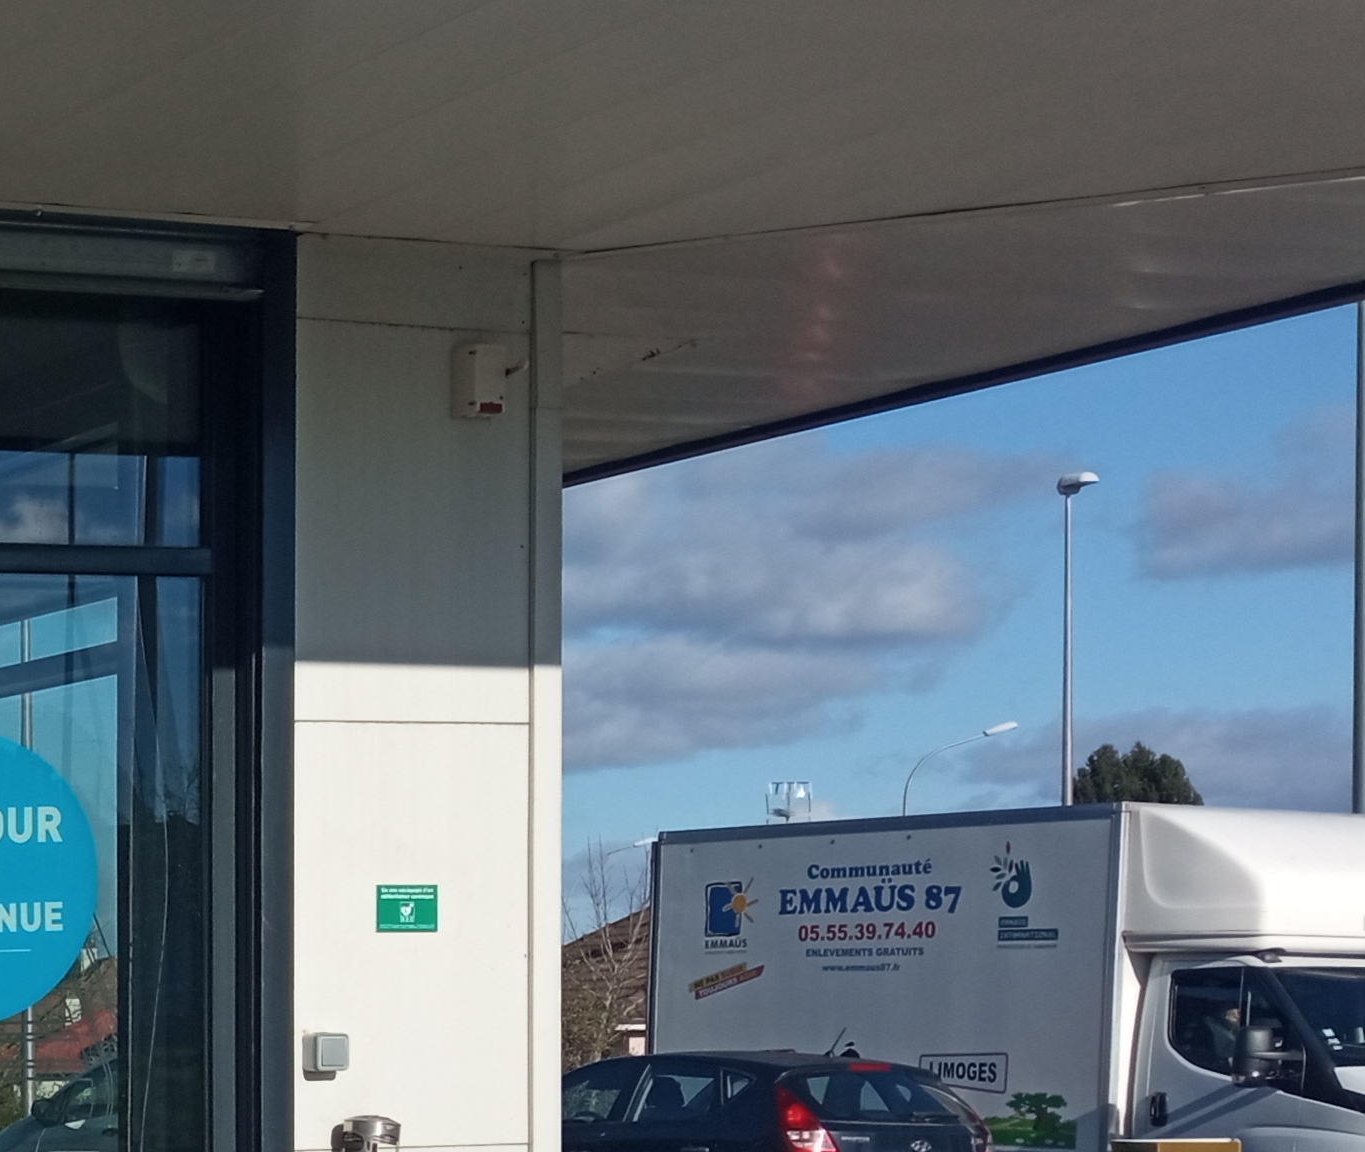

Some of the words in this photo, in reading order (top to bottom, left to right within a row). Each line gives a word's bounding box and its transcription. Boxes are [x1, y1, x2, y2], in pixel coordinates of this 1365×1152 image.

[807, 858, 933, 880] Communauté
[778, 878, 916, 915] EMMAÜS
[925, 885, 963, 914] 87
[798, 921, 936, 942] 05.55.39.74.40
[705, 937, 747, 949] EMMAÜS
[805, 948, 873, 958] ENLEVEMENTS
[876, 947, 924, 957] GRATUITS
